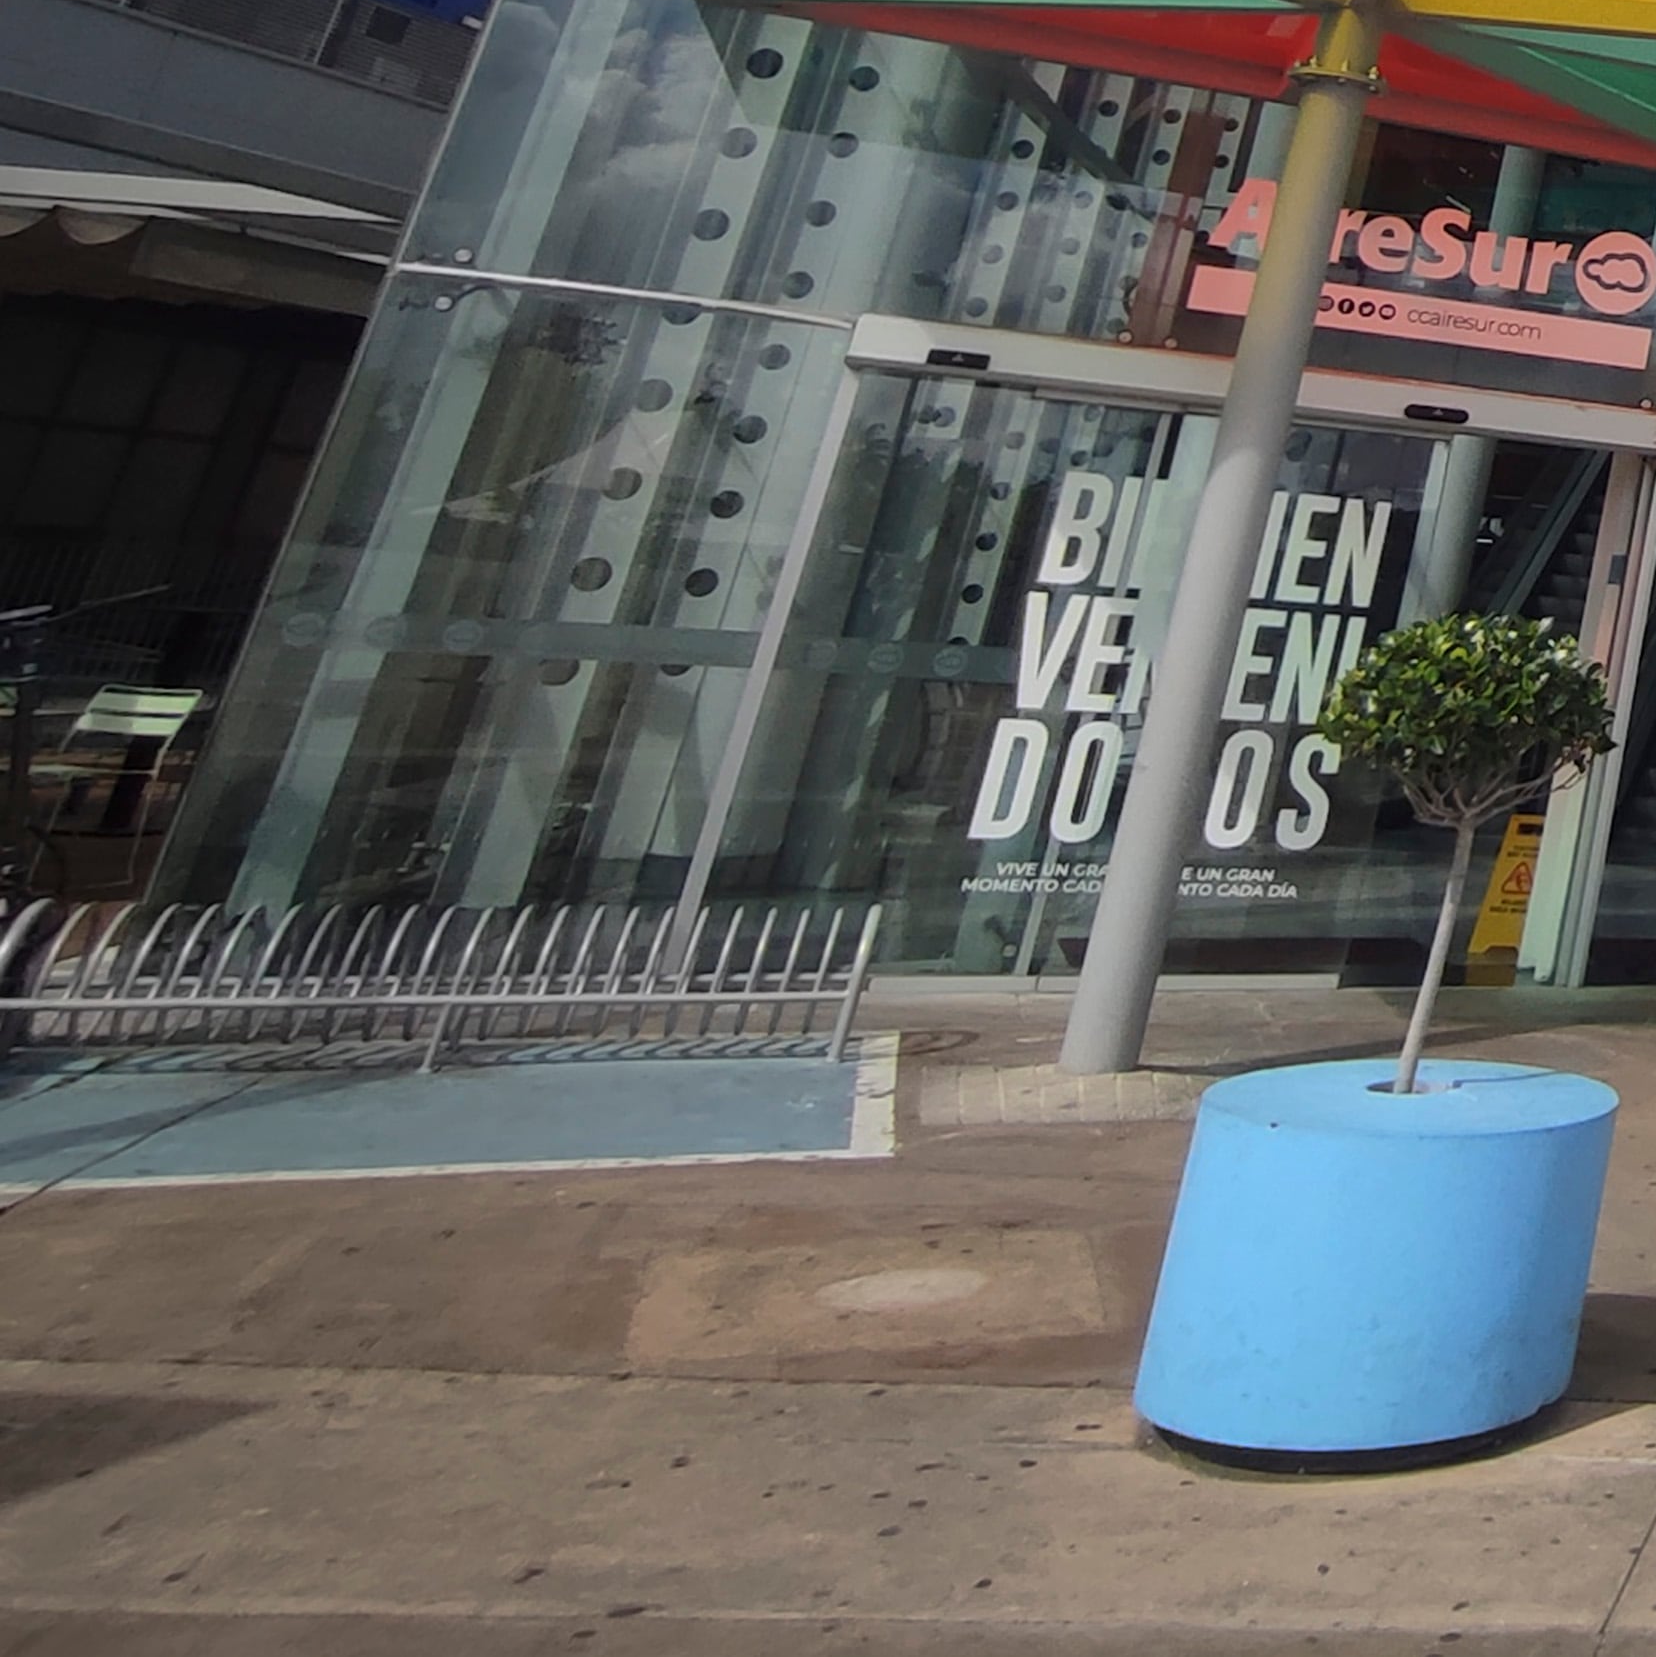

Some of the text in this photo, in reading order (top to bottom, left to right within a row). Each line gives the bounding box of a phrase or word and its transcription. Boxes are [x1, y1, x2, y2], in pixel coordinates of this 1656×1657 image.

[1207, 178, 1572, 295] AreSur
[1407, 306, 1541, 340] ccairesur.com
[1250, 491, 1392, 608] IEN
[1221, 608, 1367, 725] ENI
[967, 717, 1125, 845] DO
[1204, 729, 1342, 851] OS
[961, 878, 1101, 893] MOMENTO CAD
[996, 862, 1038, 876] VIVE
[1041, 862, 1069, 877] UN
[1196, 867, 1222, 882] UN
[1226, 868, 1276, 883] GRAN
[1216, 883, 1264, 898] CADA
[1267, 880, 1298, 899] DÍA
